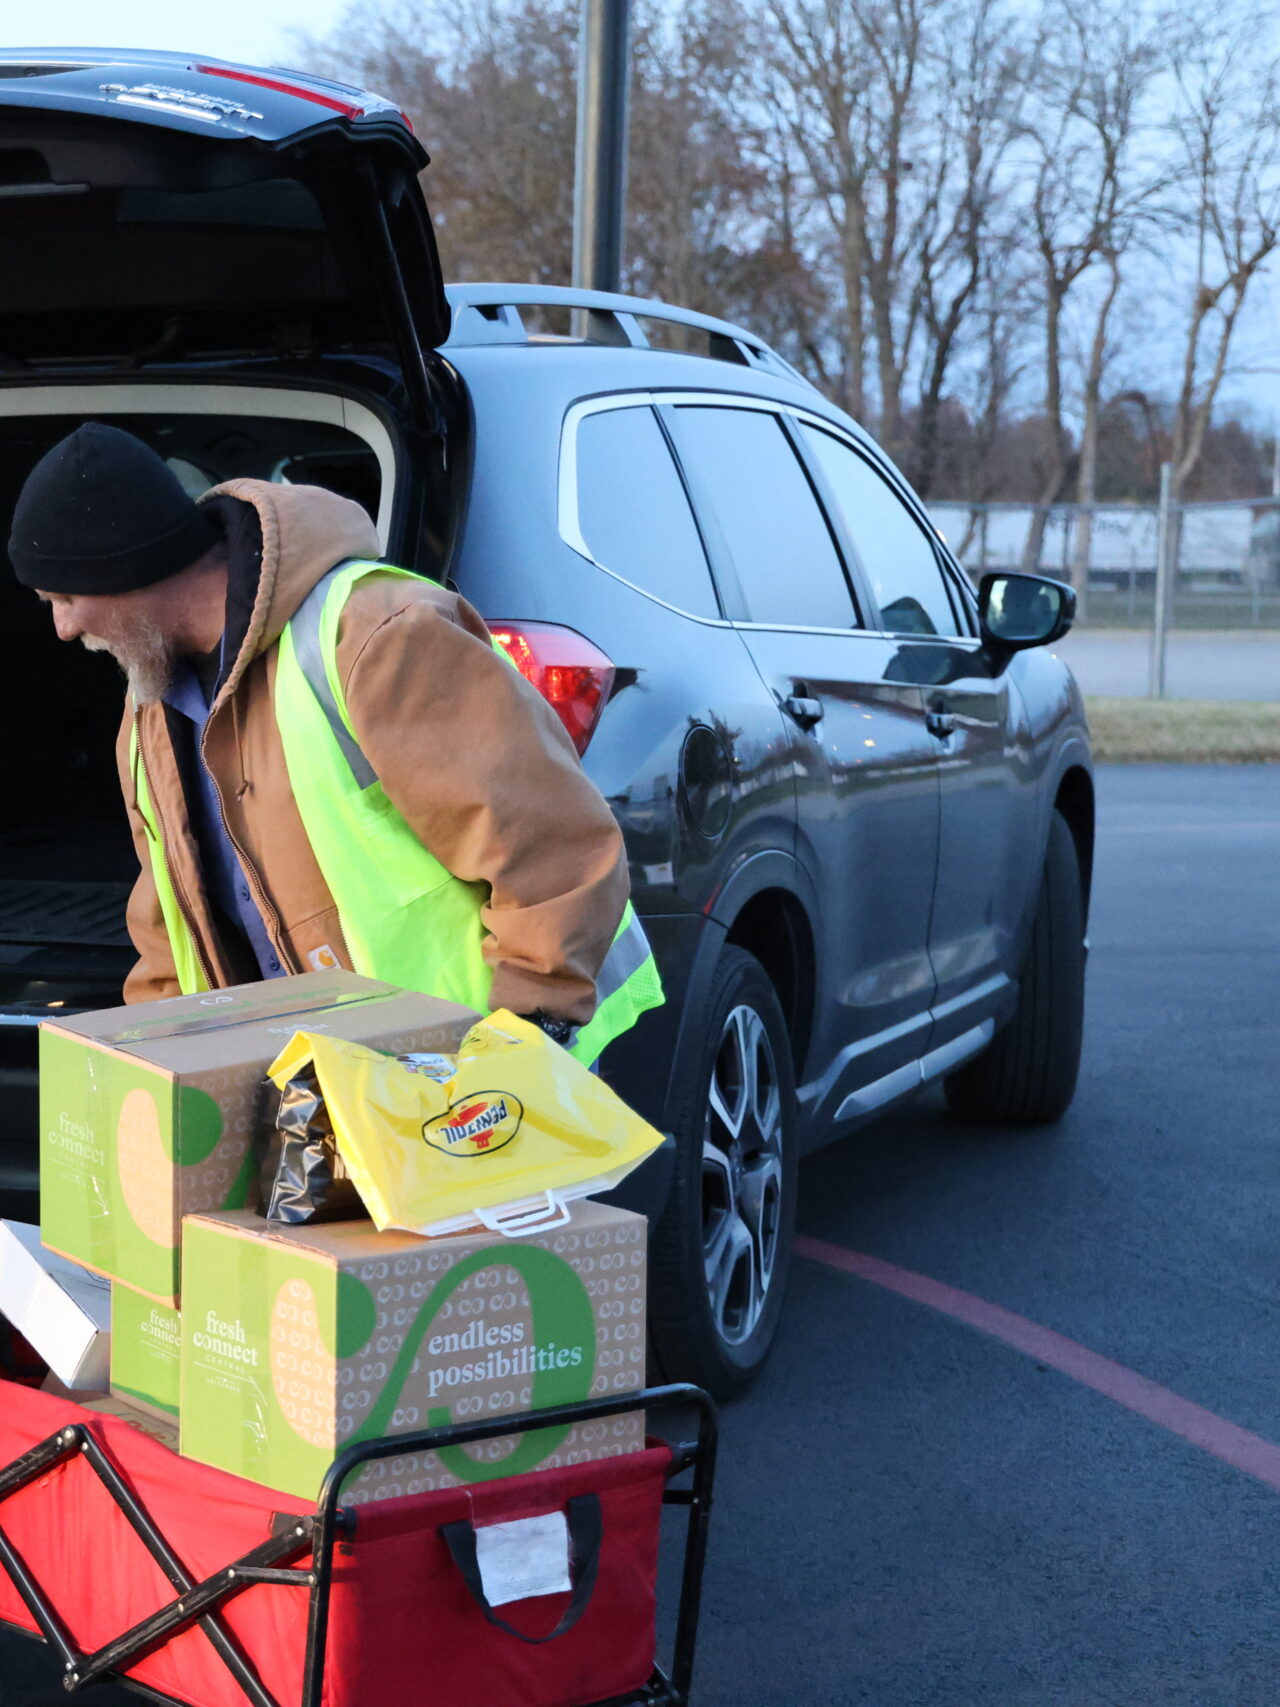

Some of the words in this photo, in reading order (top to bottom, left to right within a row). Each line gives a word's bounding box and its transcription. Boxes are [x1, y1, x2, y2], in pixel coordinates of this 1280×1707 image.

[59, 1111, 95, 1145] fresh
[47, 1130, 106, 1167] connect
[140, 1321, 181, 1347] connec
[150, 1308, 177, 1334] fresh
[206, 1309, 246, 1345] fresh
[428, 1319, 525, 1355] endless
[193, 1331, 259, 1367] connect
[427, 1342, 583, 1398] possibilities
